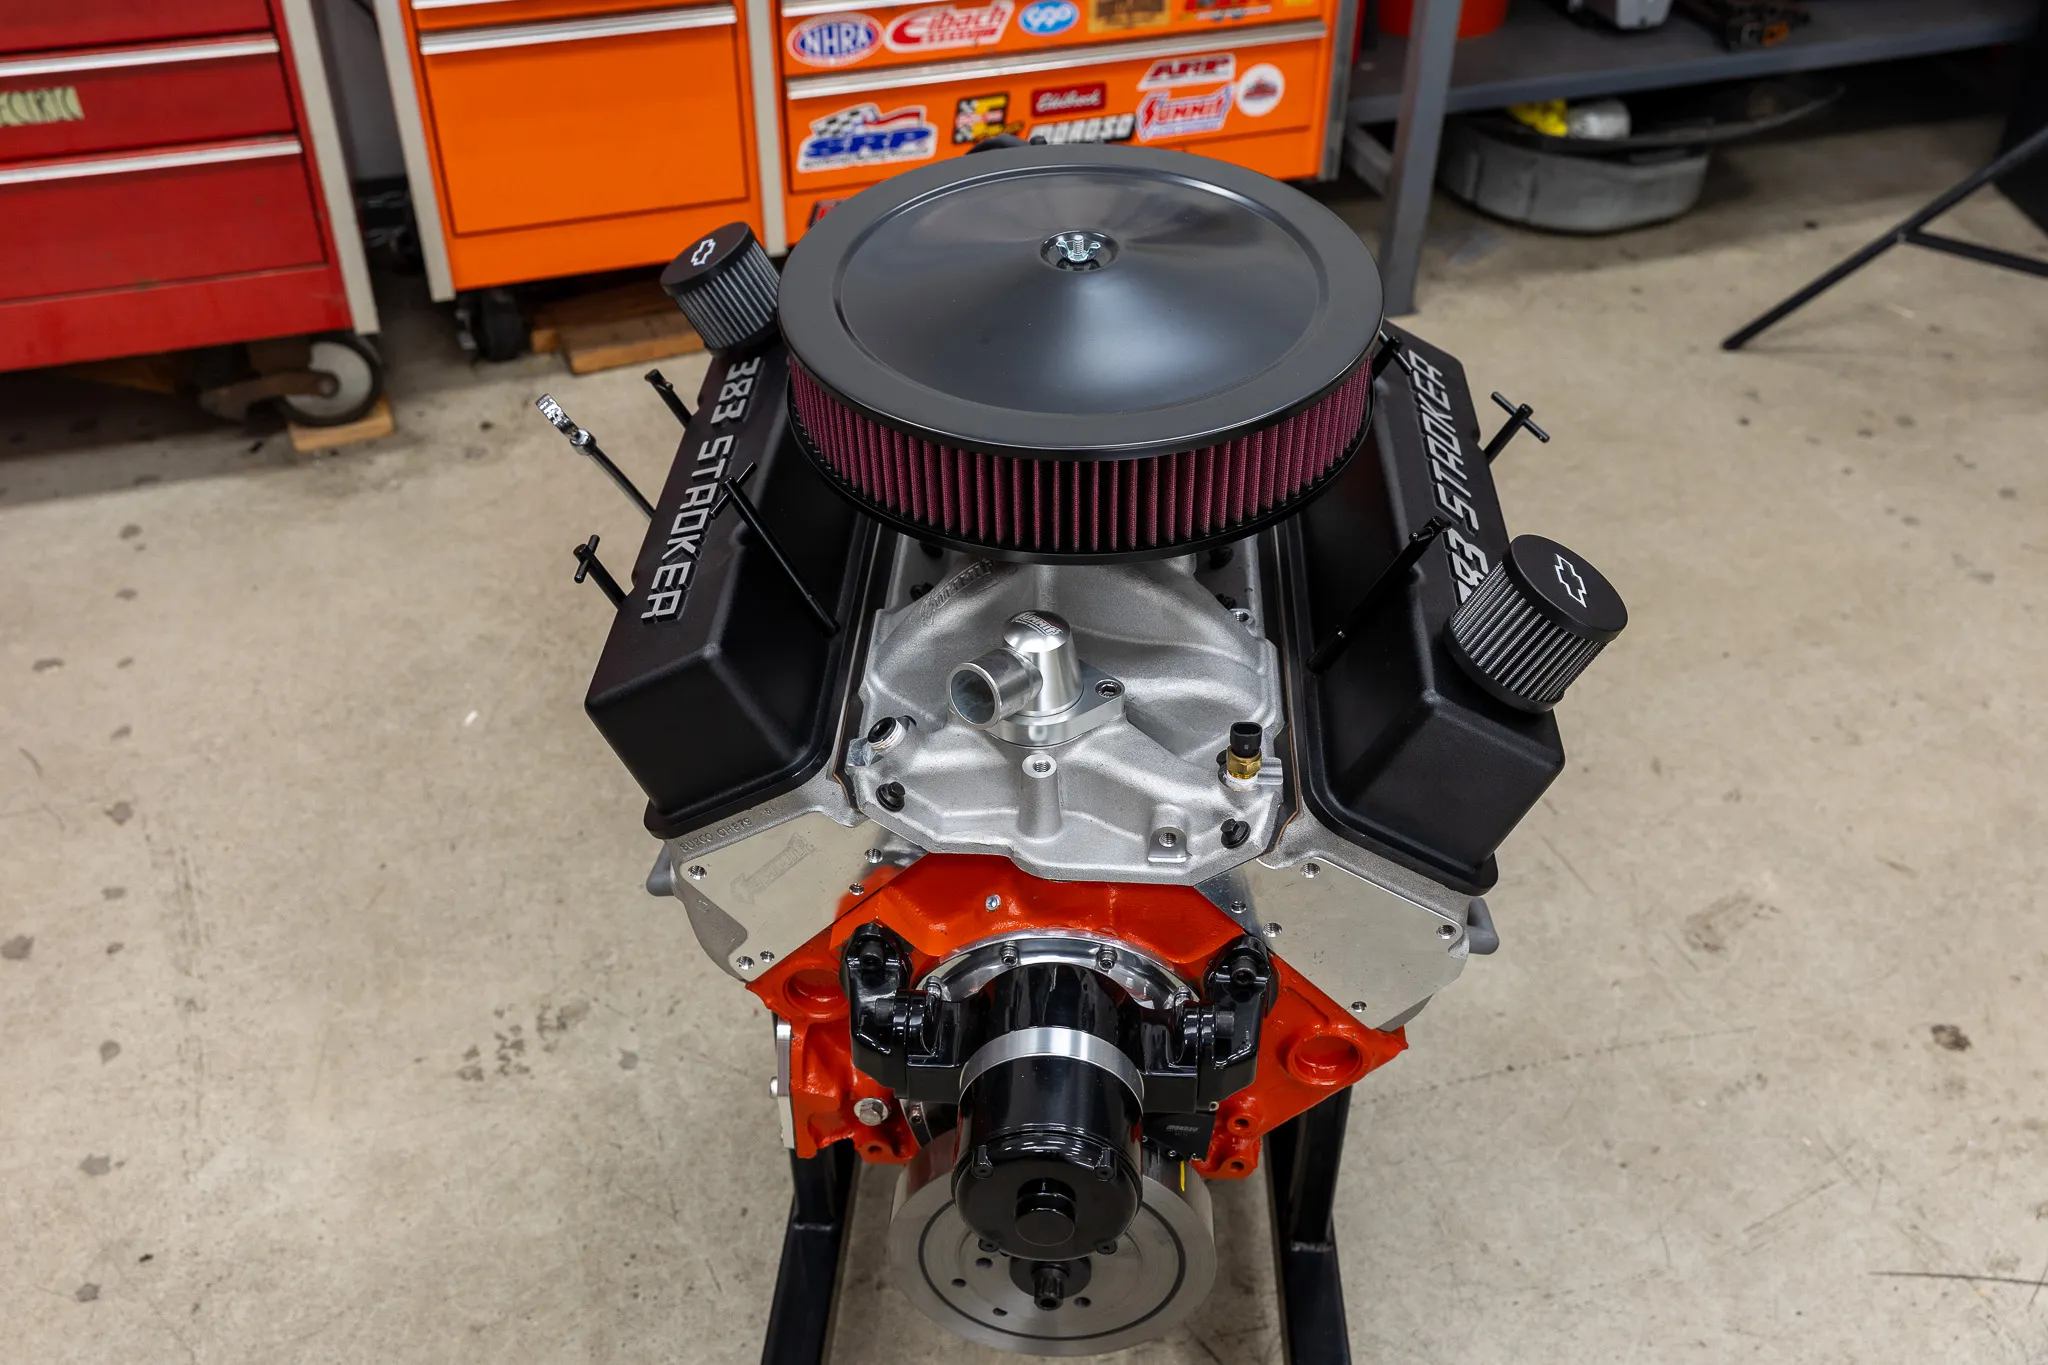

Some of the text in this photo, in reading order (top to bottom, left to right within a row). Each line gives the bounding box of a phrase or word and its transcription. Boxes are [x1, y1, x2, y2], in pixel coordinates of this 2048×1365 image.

[803, 22, 871, 56] NHRA
[641, 356, 761, 619] 383 STROKER
[1409, 349, 1489, 604] 83 STROKER
